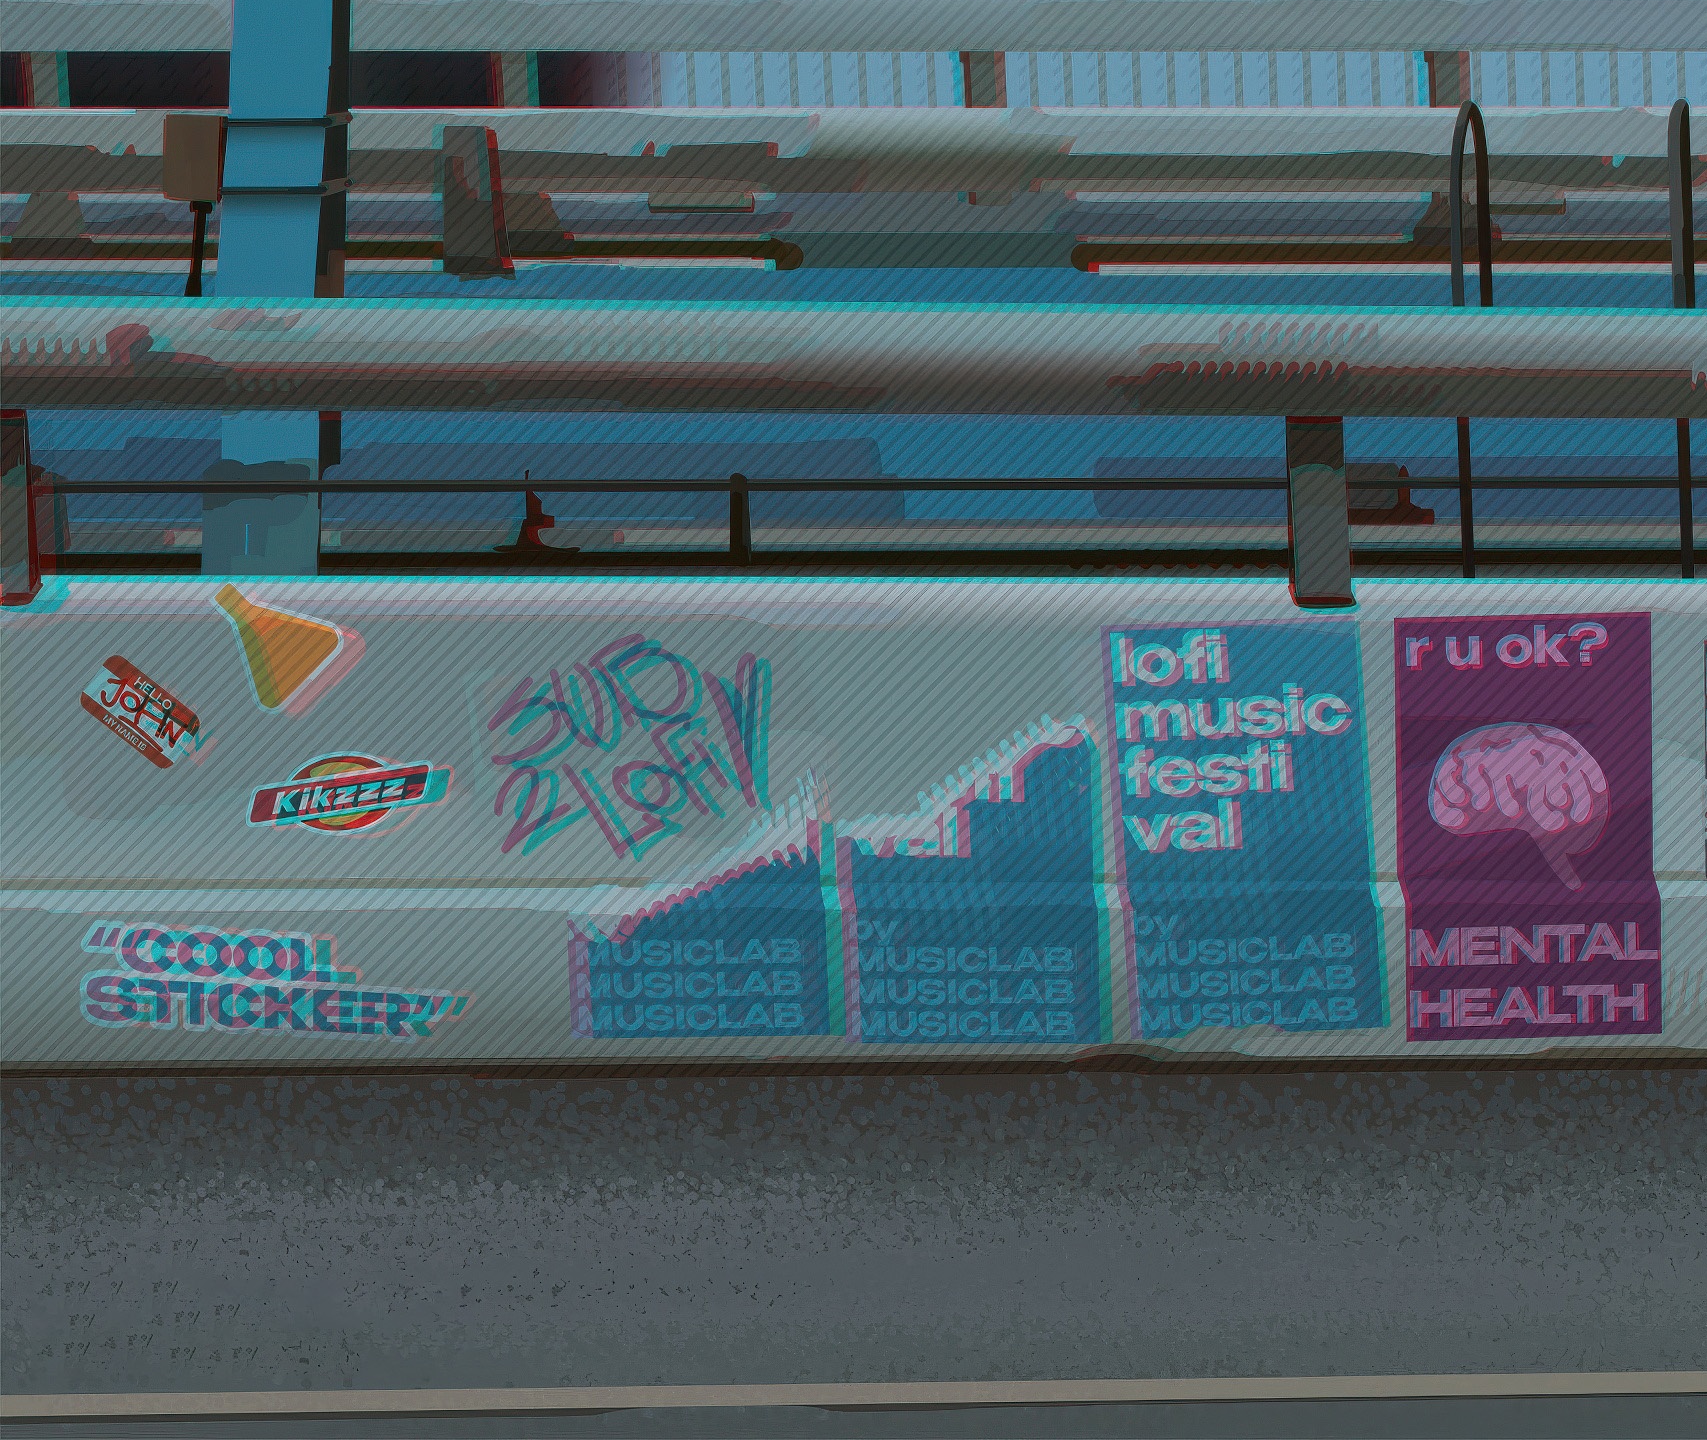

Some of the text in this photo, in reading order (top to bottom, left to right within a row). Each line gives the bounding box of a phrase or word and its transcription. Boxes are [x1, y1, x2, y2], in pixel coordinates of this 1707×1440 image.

[1109, 628, 1230, 687] lofi
[1405, 621, 1609, 671] r u ok?
[134, 676, 172, 710] HELLO
[102, 714, 117, 728] MY
[1115, 682, 1352, 742] music
[1118, 739, 1295, 798] festi
[1122, 797, 1243, 853] val
[575, 938, 801, 967] MUSICLAB
[850, 946, 1077, 974] MUSICLAB
[1134, 932, 1355, 967] MUSICLAB
[1409, 922, 1661, 967] MENTAL
[576, 970, 804, 999] MUSICLAB
[851, 978, 1077, 1006] MUSICLAB
[1135, 964, 1357, 999] MUSICLAB
[578, 1002, 805, 1031] MUSICLAB
[1138, 996, 1359, 1031] MUSICLAB
[1409, 983, 1649, 1028] HEALTH
[852, 1010, 1077, 1038] MUSICLAB
